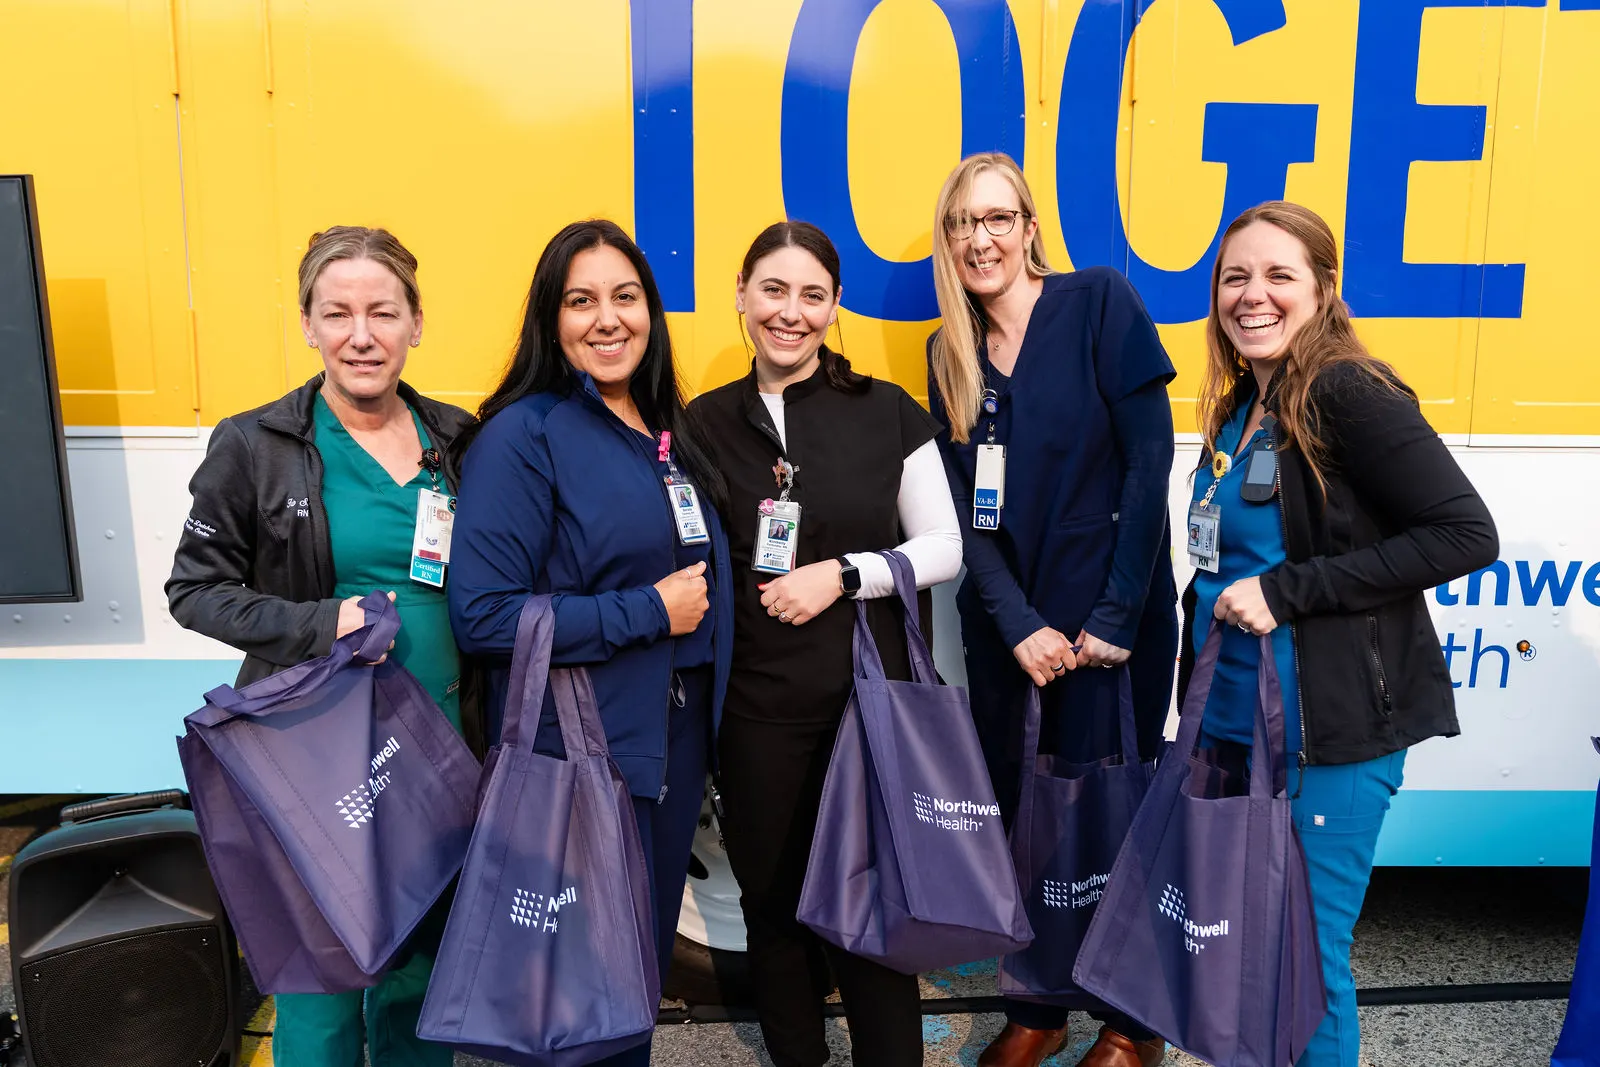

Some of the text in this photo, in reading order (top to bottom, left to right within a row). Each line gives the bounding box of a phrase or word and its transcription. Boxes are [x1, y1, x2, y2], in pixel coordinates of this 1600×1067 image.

[630, 0, 1600, 323] TOGE
[977, 497, 996, 506] VA-BC
[297, 509, 309, 517] RN
[978, 514, 995, 527] RN
[414, 561, 441, 575] Certified
[1198, 556, 1209, 568] RN
[421, 570, 433, 580] RN
